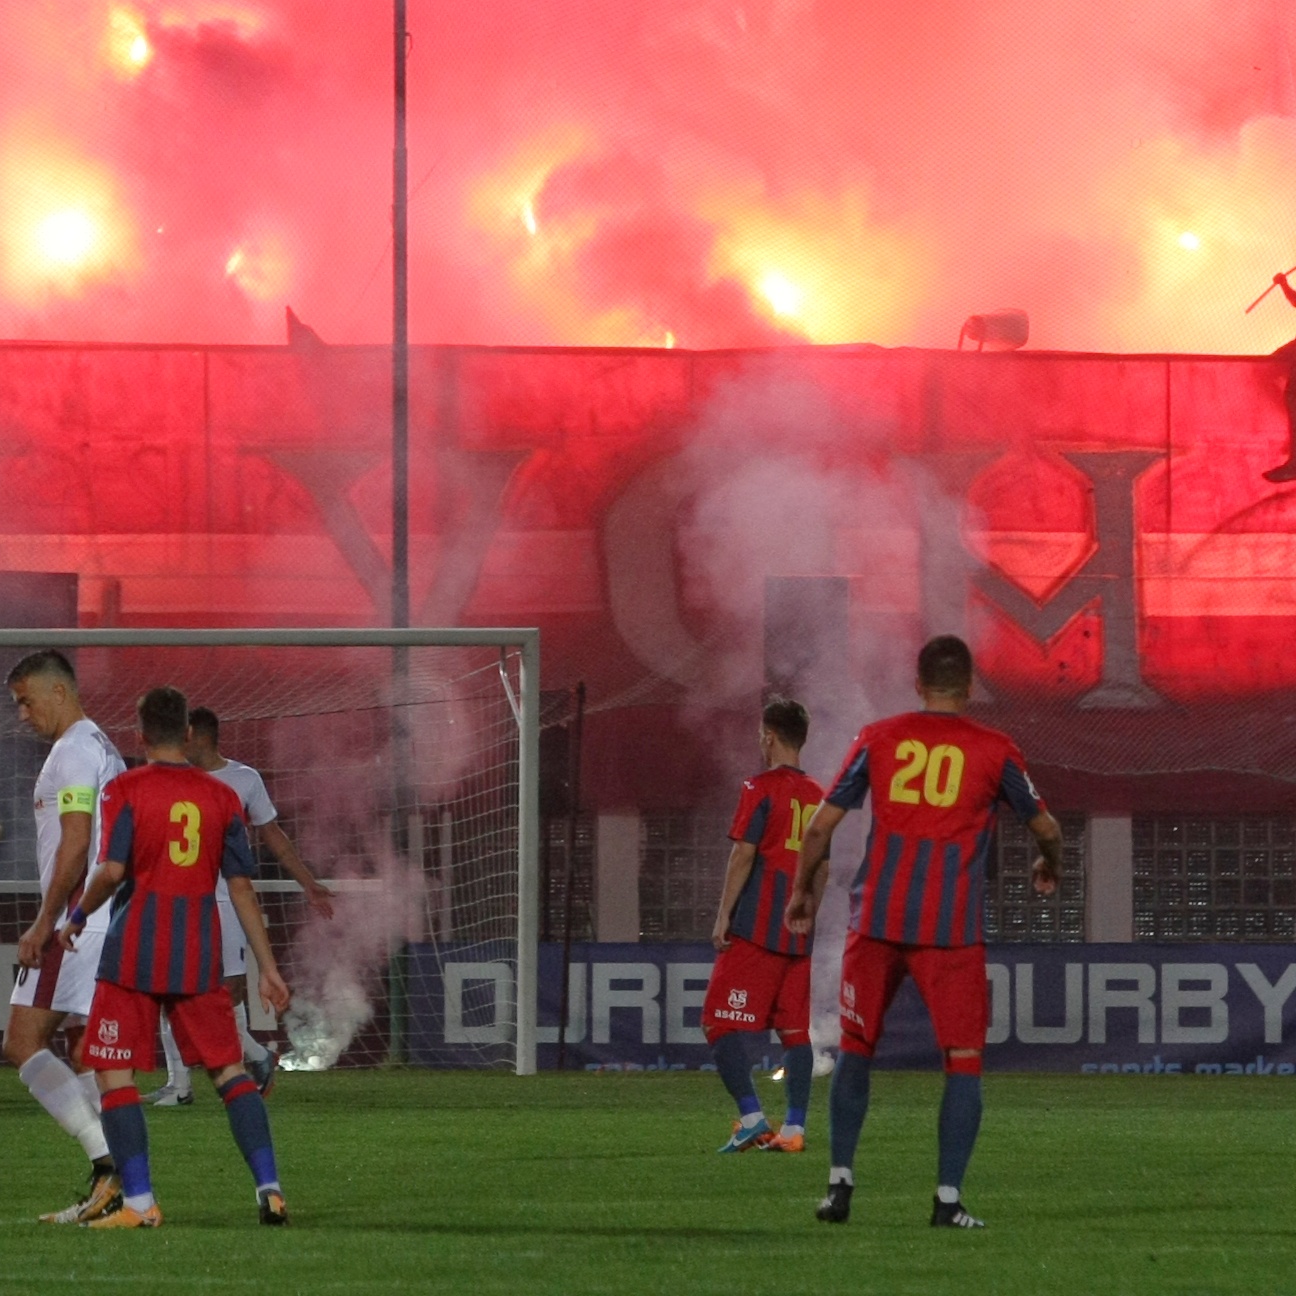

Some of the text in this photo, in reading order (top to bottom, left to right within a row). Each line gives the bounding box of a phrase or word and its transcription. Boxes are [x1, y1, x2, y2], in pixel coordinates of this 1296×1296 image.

[889, 739, 964, 808] 20
[168, 801, 202, 867] 3
[714, 1009, 755, 1023] as47.ro
